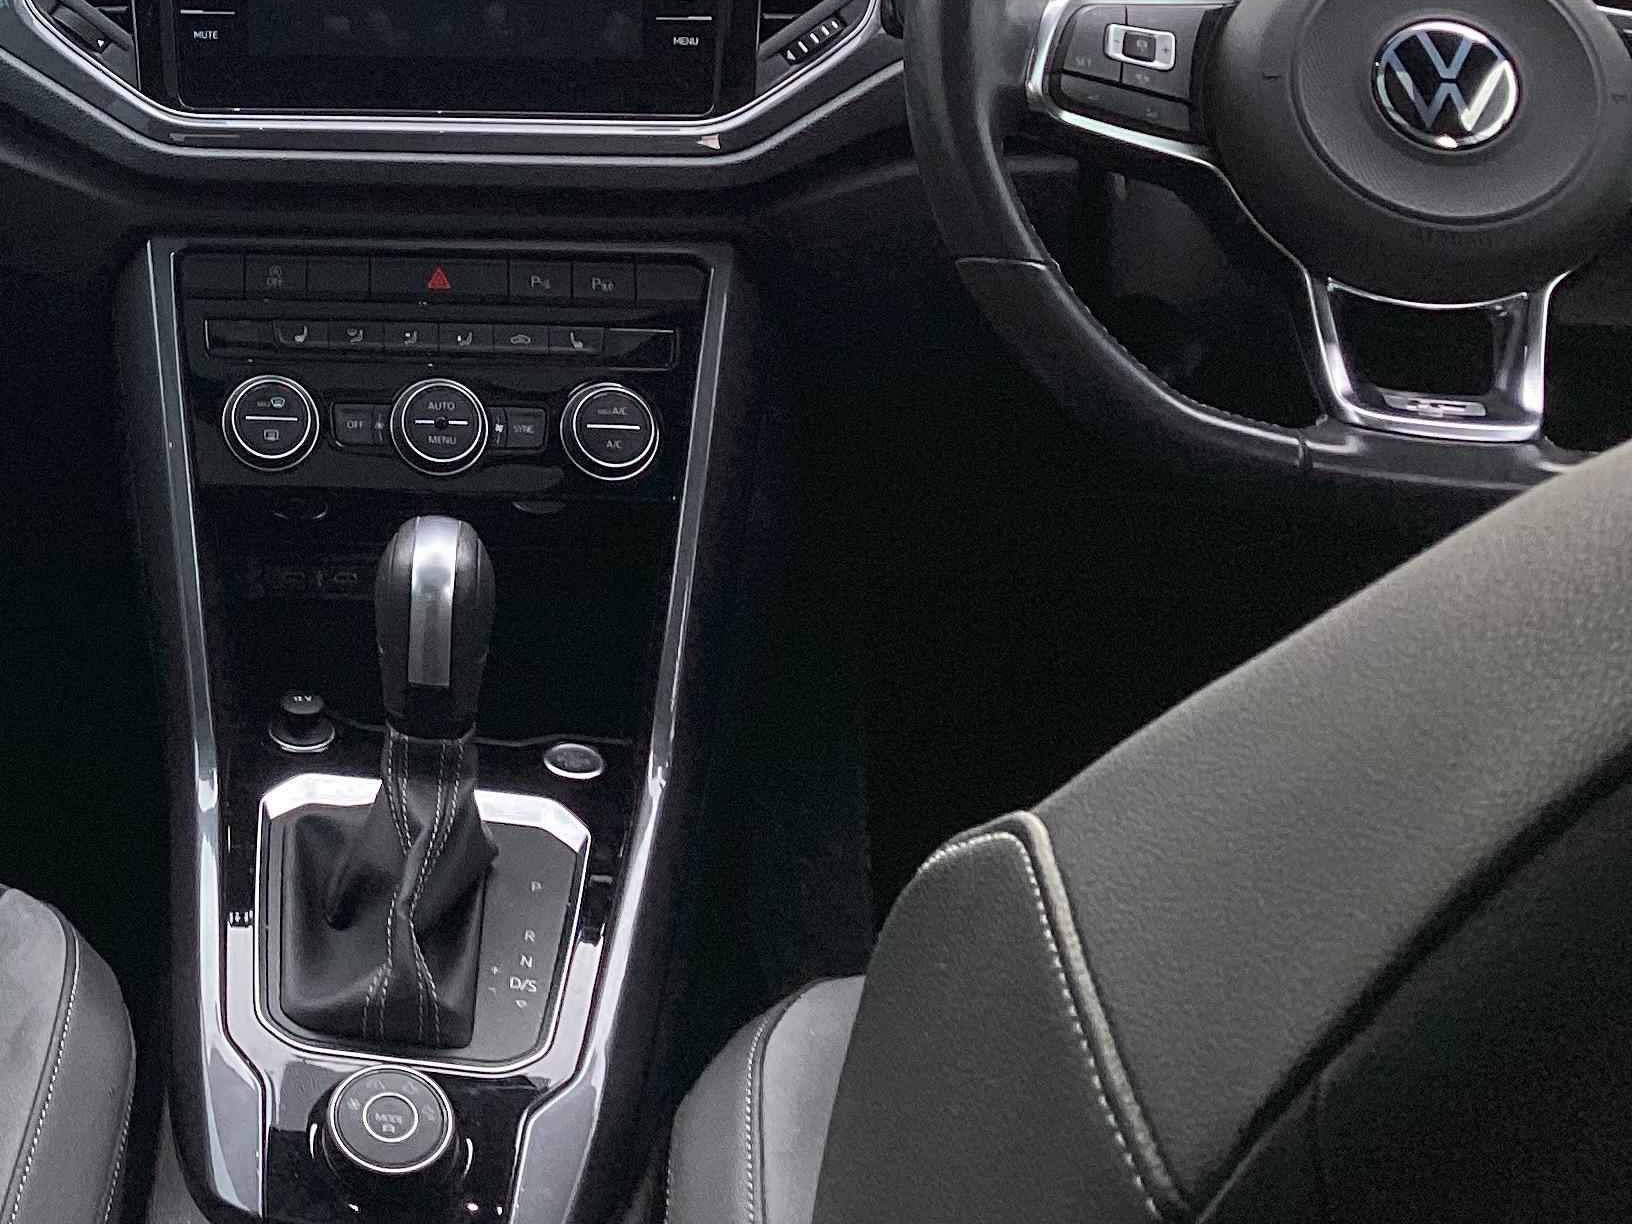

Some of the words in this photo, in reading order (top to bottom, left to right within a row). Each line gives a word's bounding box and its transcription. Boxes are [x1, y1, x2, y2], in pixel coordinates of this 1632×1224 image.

[193, 30, 218, 39] MUTE
[673, 37, 699, 46] MENU
[427, 401, 456, 411] AUTO
[346, 419, 364, 429] OFF
[512, 425, 535, 434] SYNC
[428, 436, 457, 445] MENU
[606, 440, 622, 449] A/C
[531, 881, 542, 892] P
[524, 929, 536, 943] R
[519, 955, 533, 968] N
[509, 976, 537, 993] D/S
